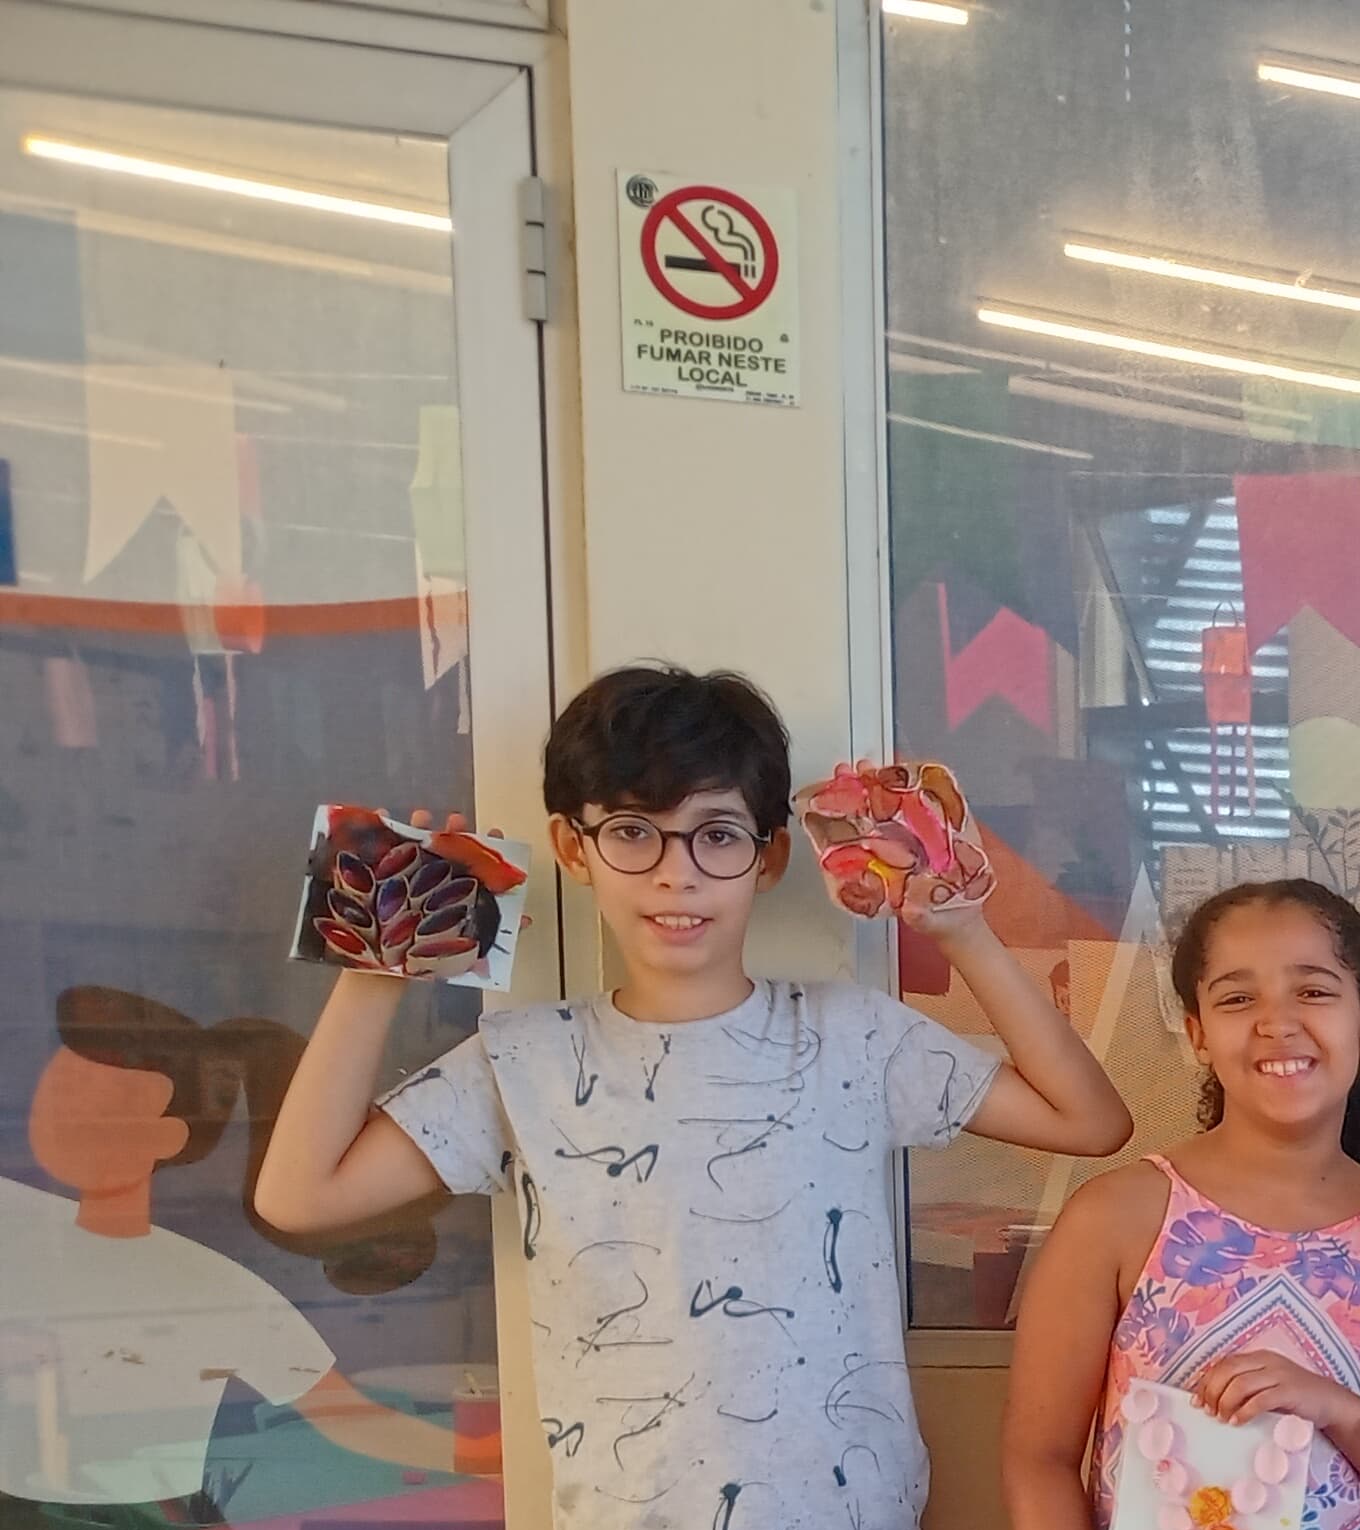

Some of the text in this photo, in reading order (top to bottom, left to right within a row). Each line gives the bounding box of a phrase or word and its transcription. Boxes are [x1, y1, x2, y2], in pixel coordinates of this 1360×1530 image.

[660, 329, 763, 353] PROIBIDO
[637, 344, 786, 374] FUMAR NESTE
[678, 366, 748, 388] LOCAL
